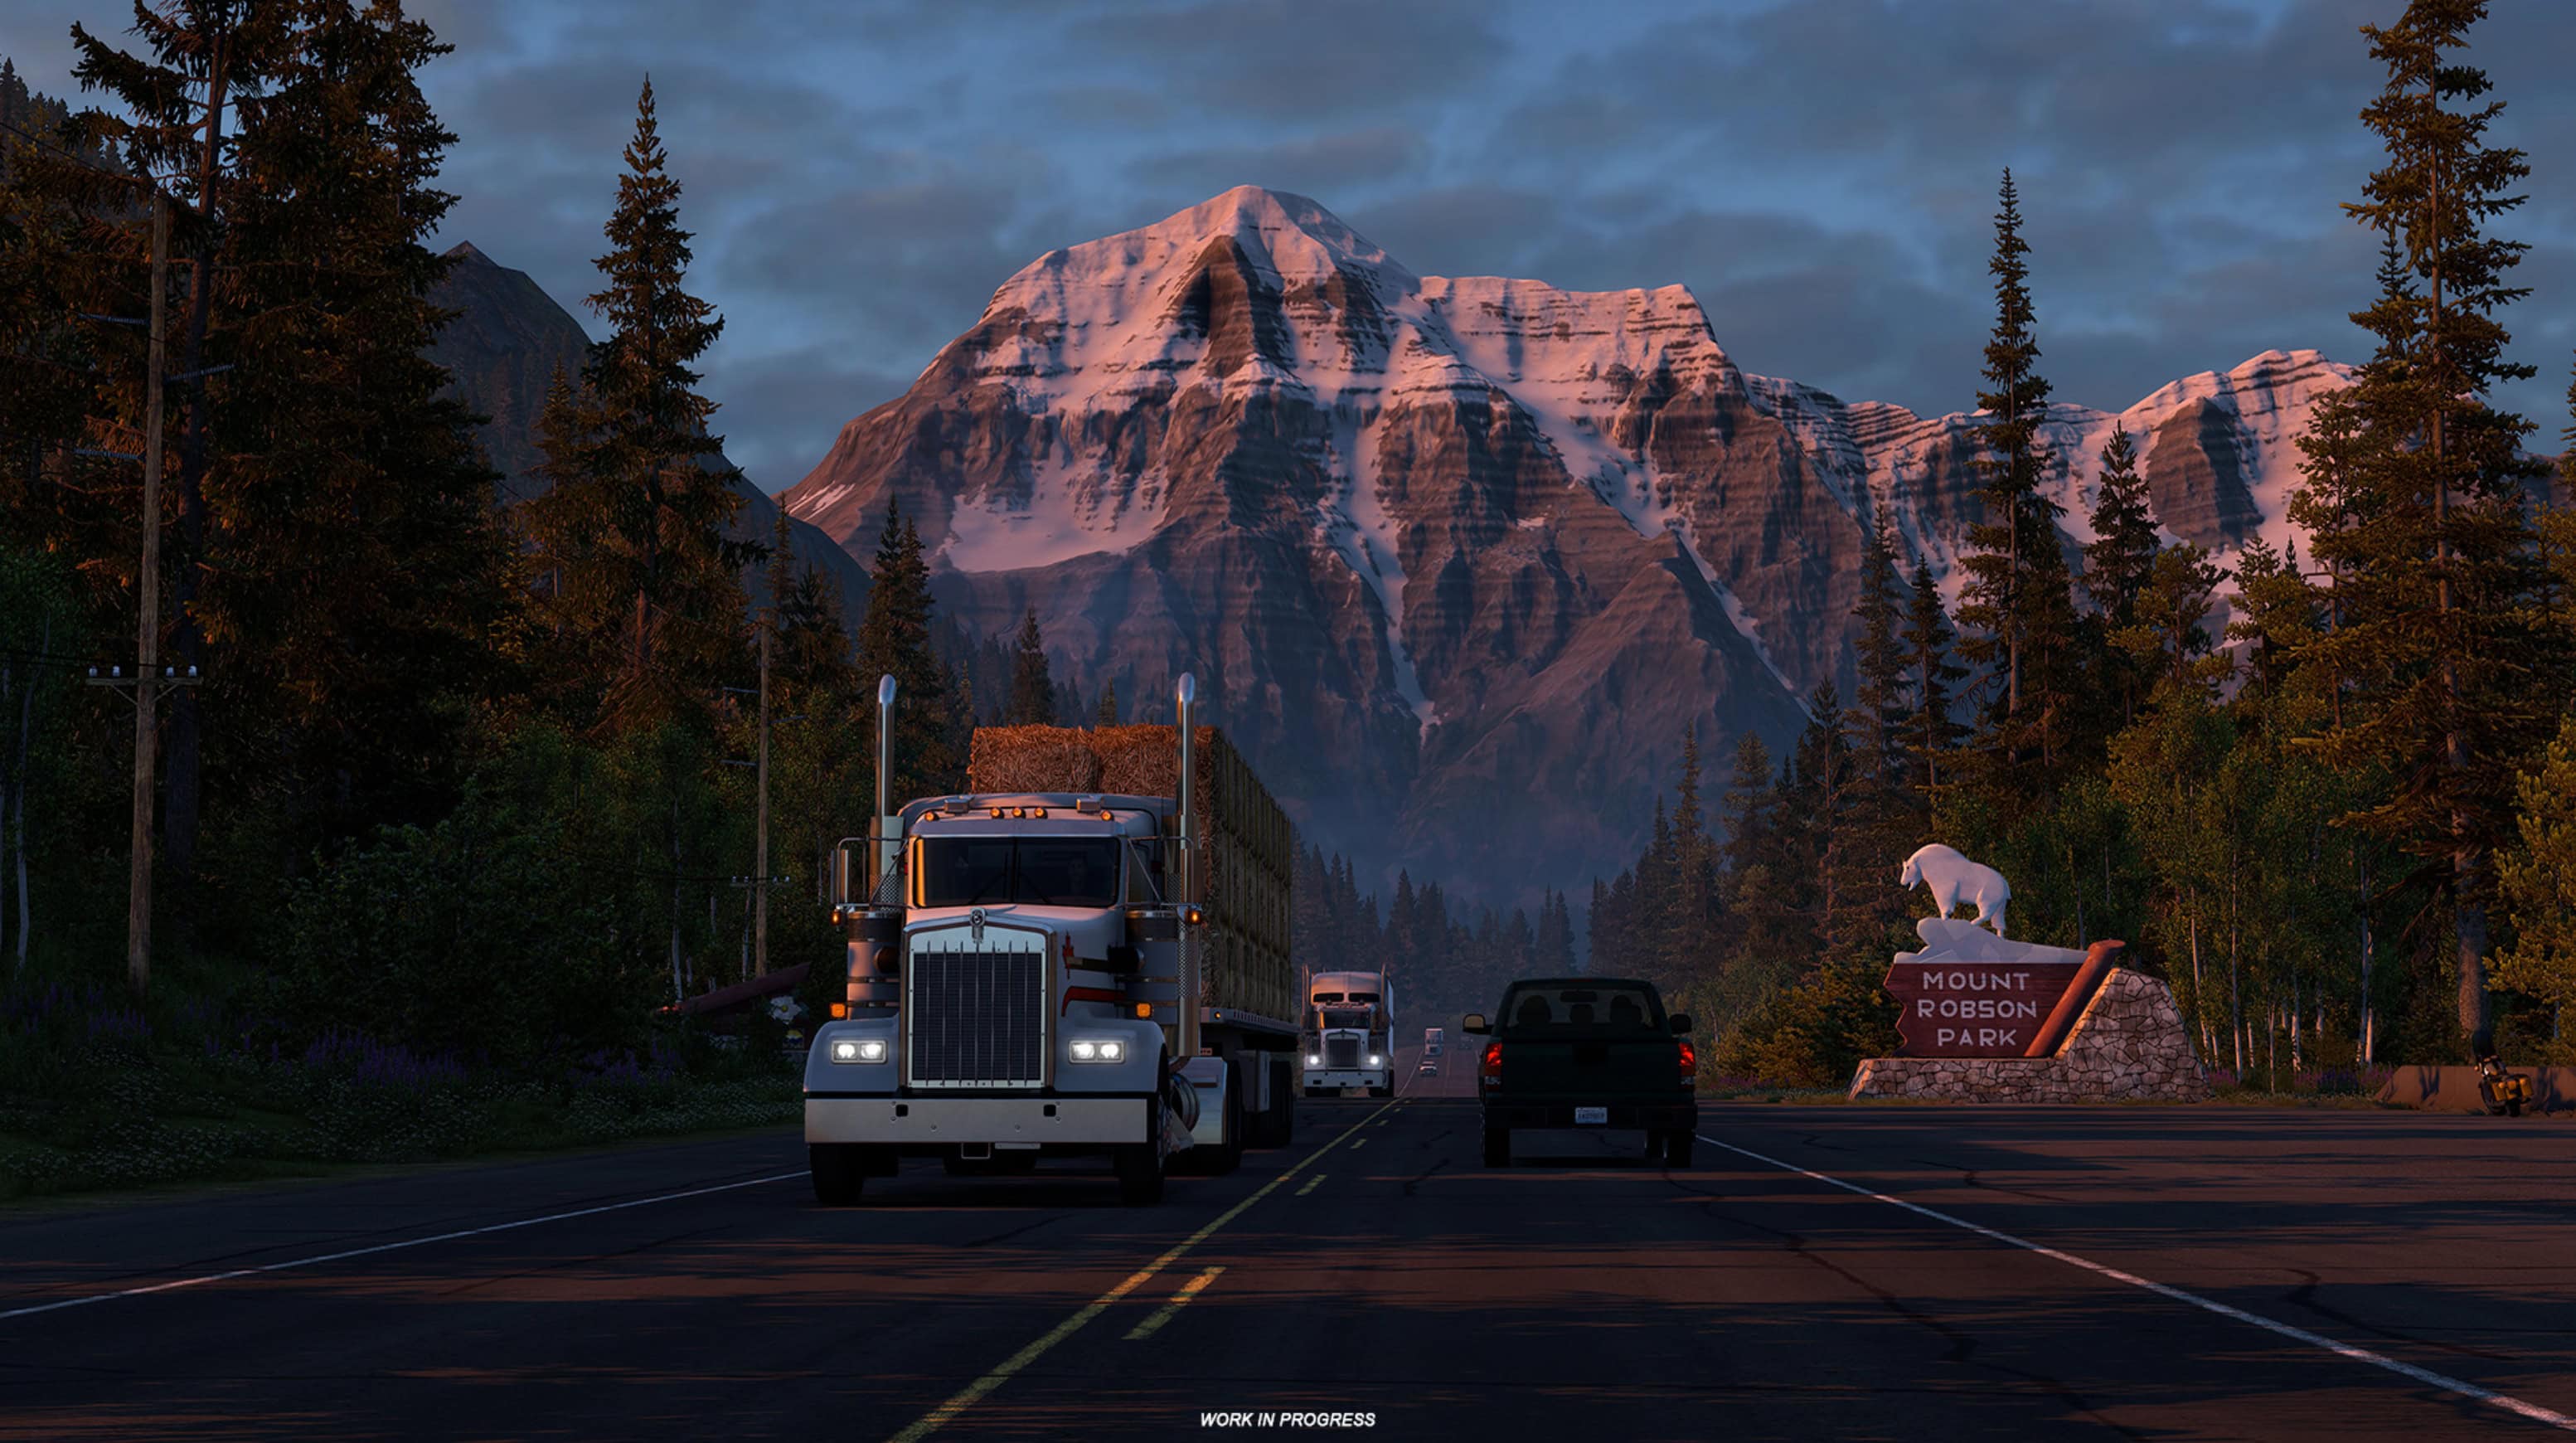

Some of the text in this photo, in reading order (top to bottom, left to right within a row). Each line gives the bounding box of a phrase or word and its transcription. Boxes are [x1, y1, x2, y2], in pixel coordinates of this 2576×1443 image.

[1923, 971, 2030, 991] MOUNT
[1917, 998, 2037, 1018] ROBSON
[1937, 1028, 2017, 1047] PARK
